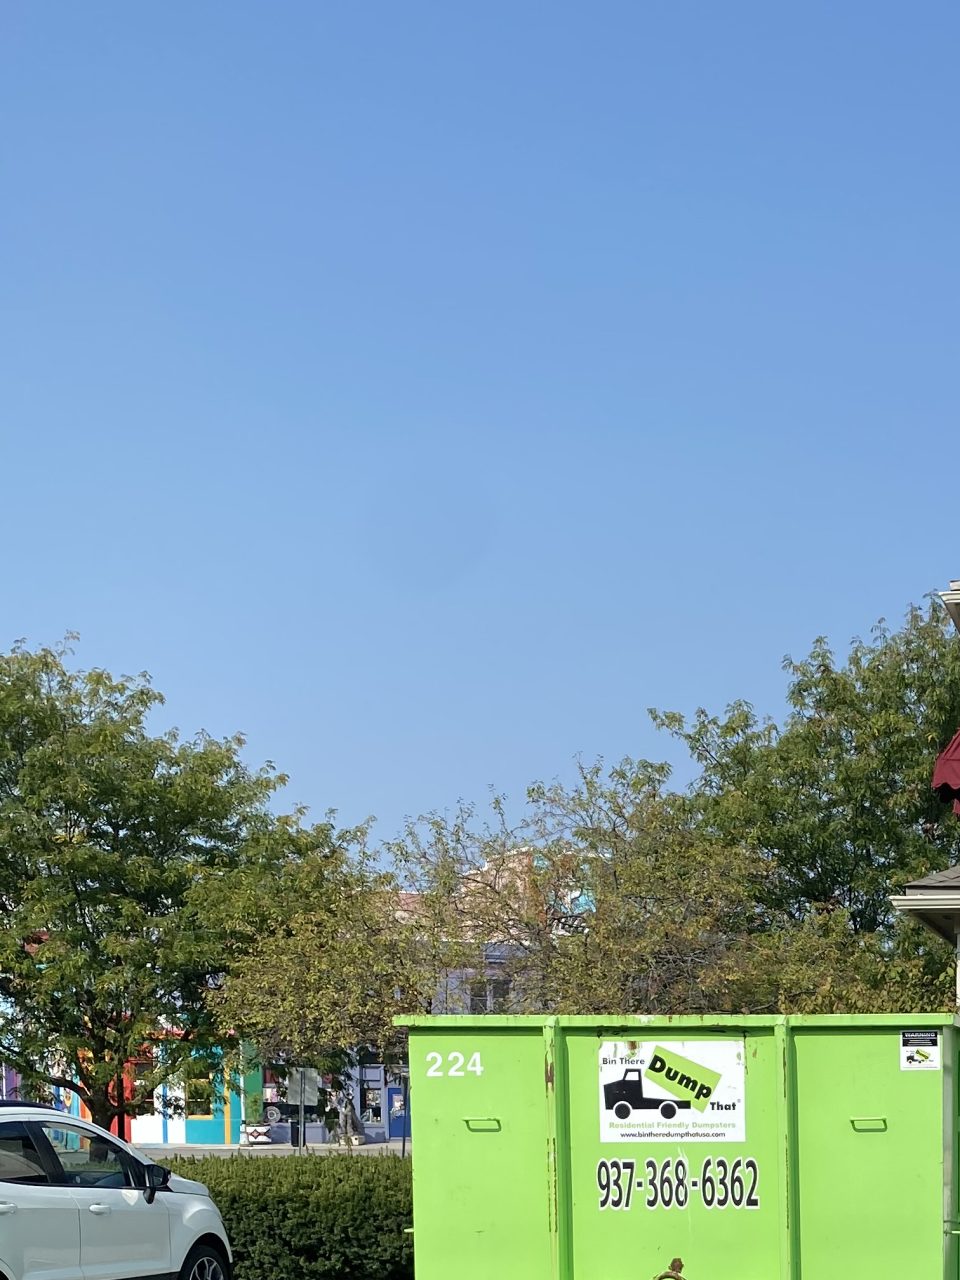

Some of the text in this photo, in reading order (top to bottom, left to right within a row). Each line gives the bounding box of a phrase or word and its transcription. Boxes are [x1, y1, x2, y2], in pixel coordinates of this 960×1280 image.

[425, 1051, 484, 1077] 224
[602, 1057, 645, 1065] Bin There
[648, 1054, 712, 1100] Dump
[709, 1101, 737, 1111] That
[608, 1121, 736, 1130] Residential Friendly Dumpsters
[620, 1131, 726, 1139] www.bintheredumpthatusa.com
[597, 1158, 760, 1209] 937-368-6362
